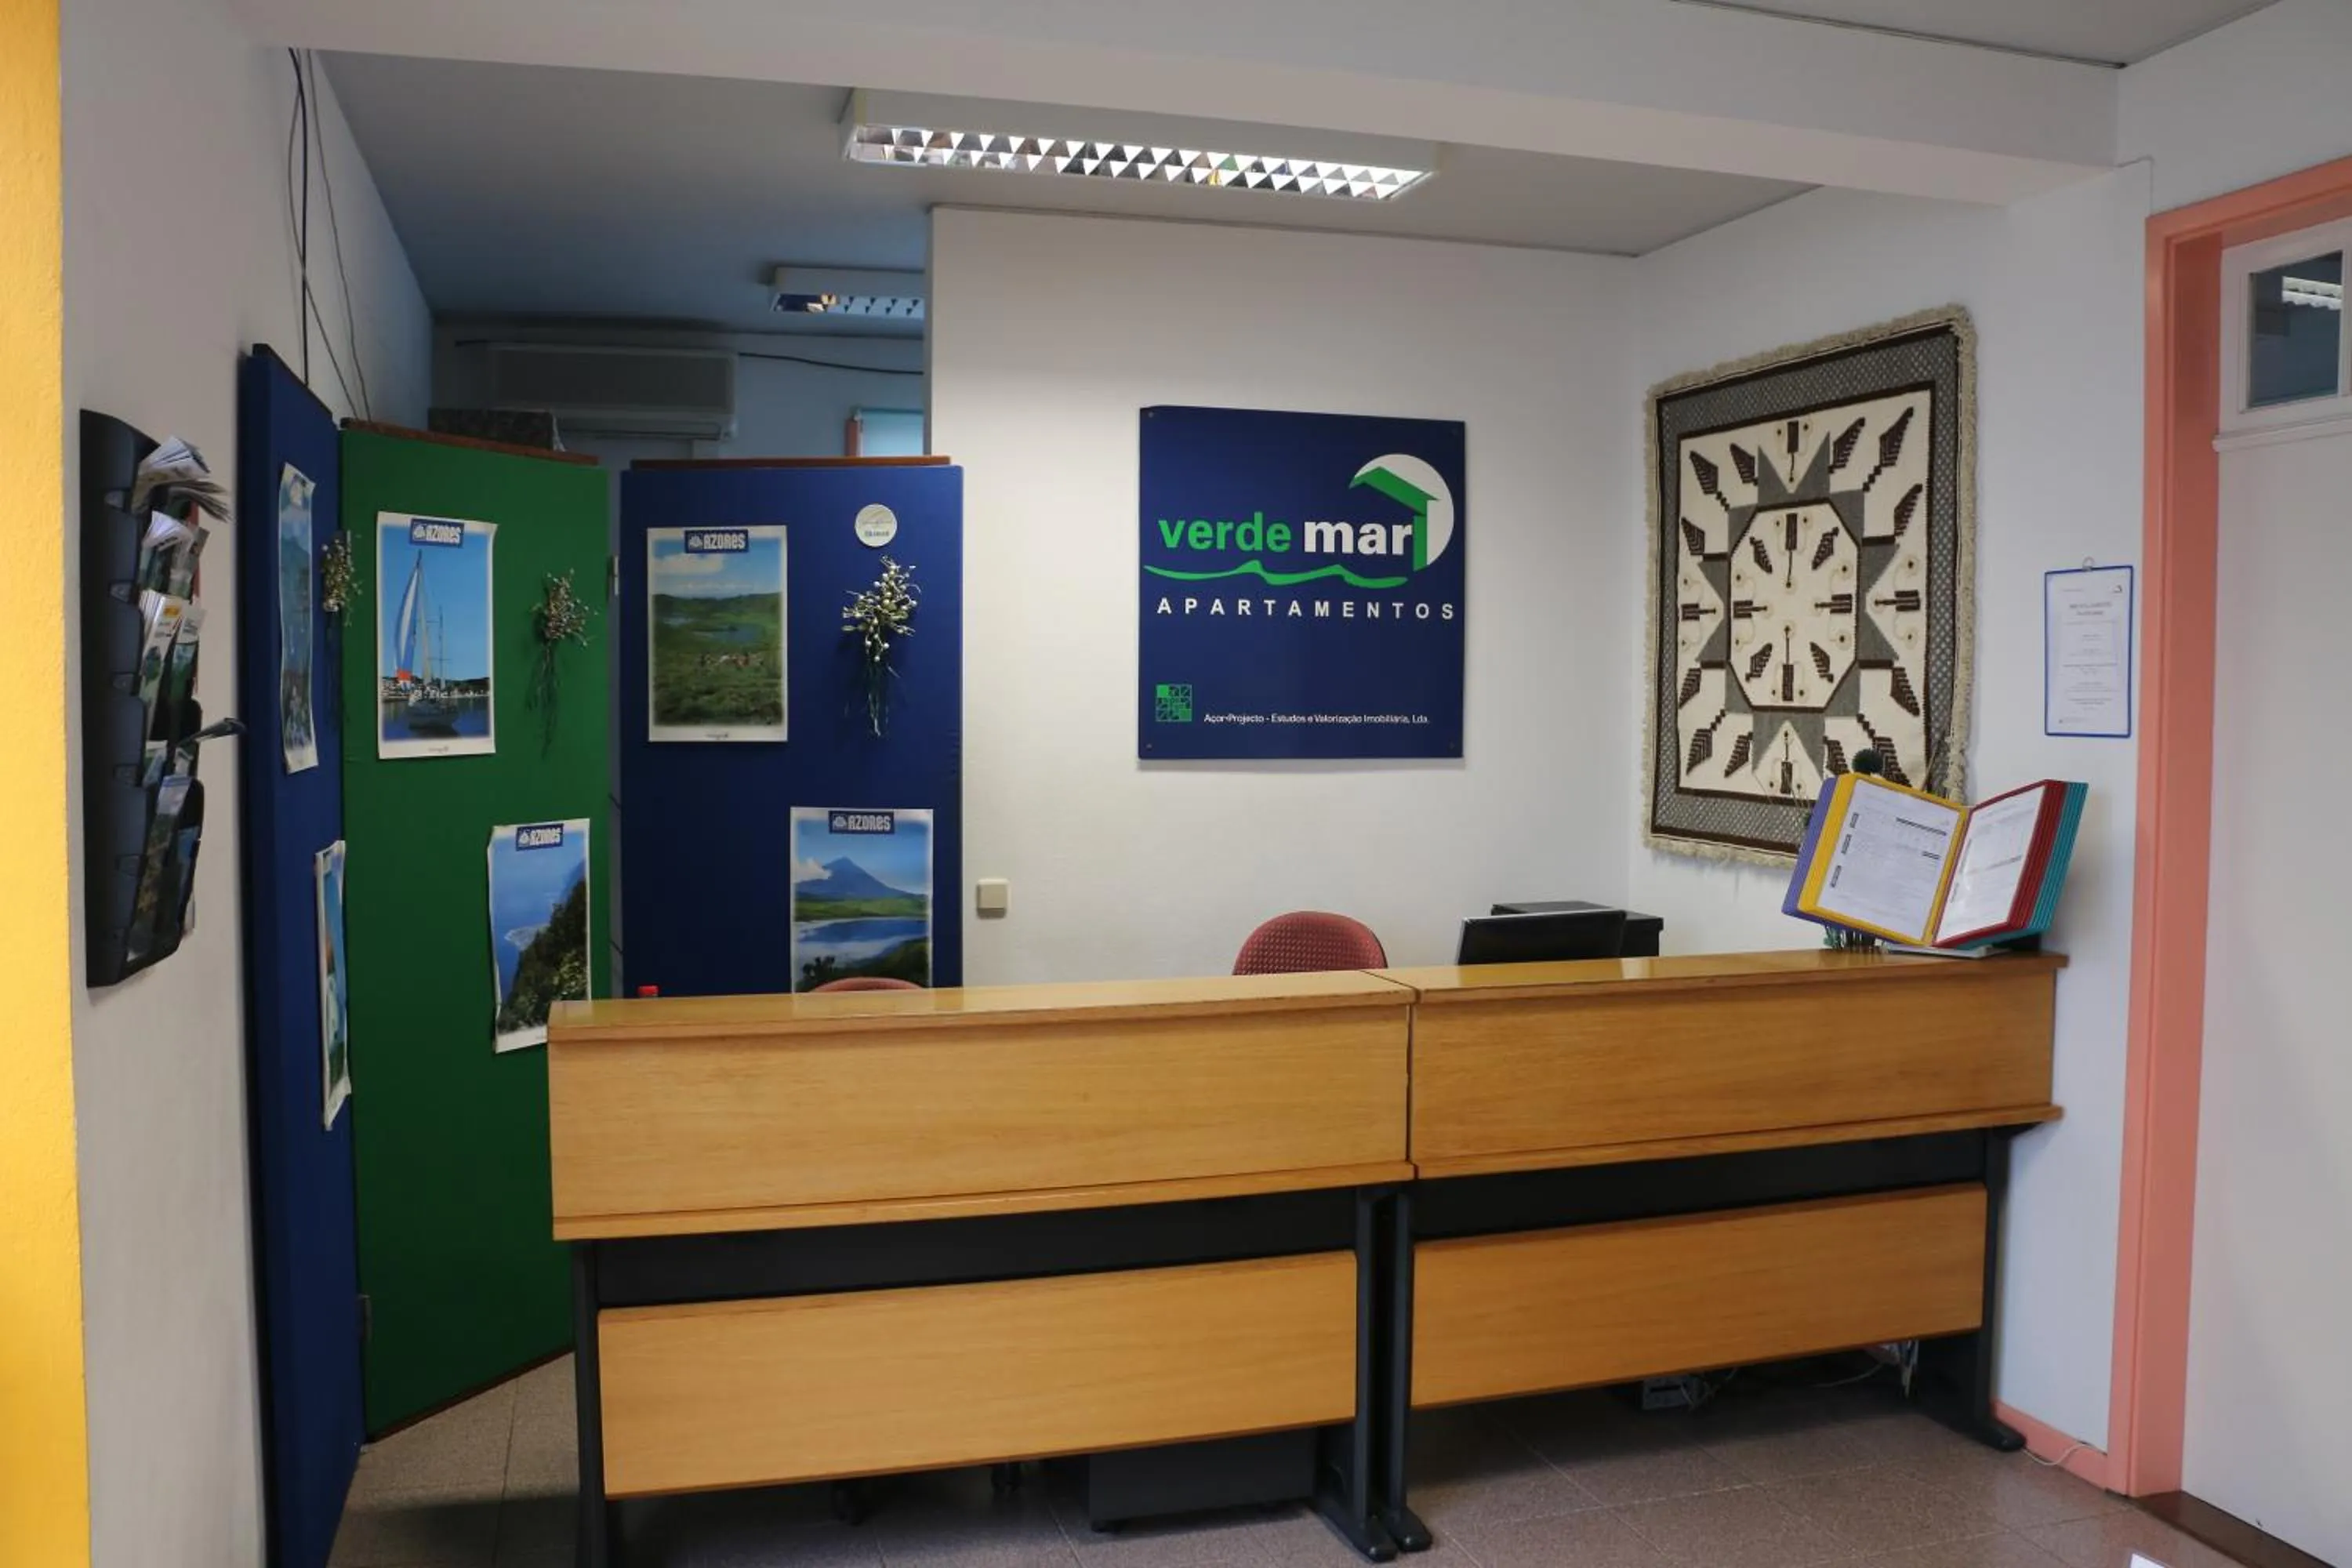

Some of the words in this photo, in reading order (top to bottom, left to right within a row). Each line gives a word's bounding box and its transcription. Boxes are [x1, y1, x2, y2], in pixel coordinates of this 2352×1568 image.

[1158, 511, 1291, 551] verde
[1304, 521, 1412, 555] mar
[1156, 597, 1454, 620] APARTAMENTOS
